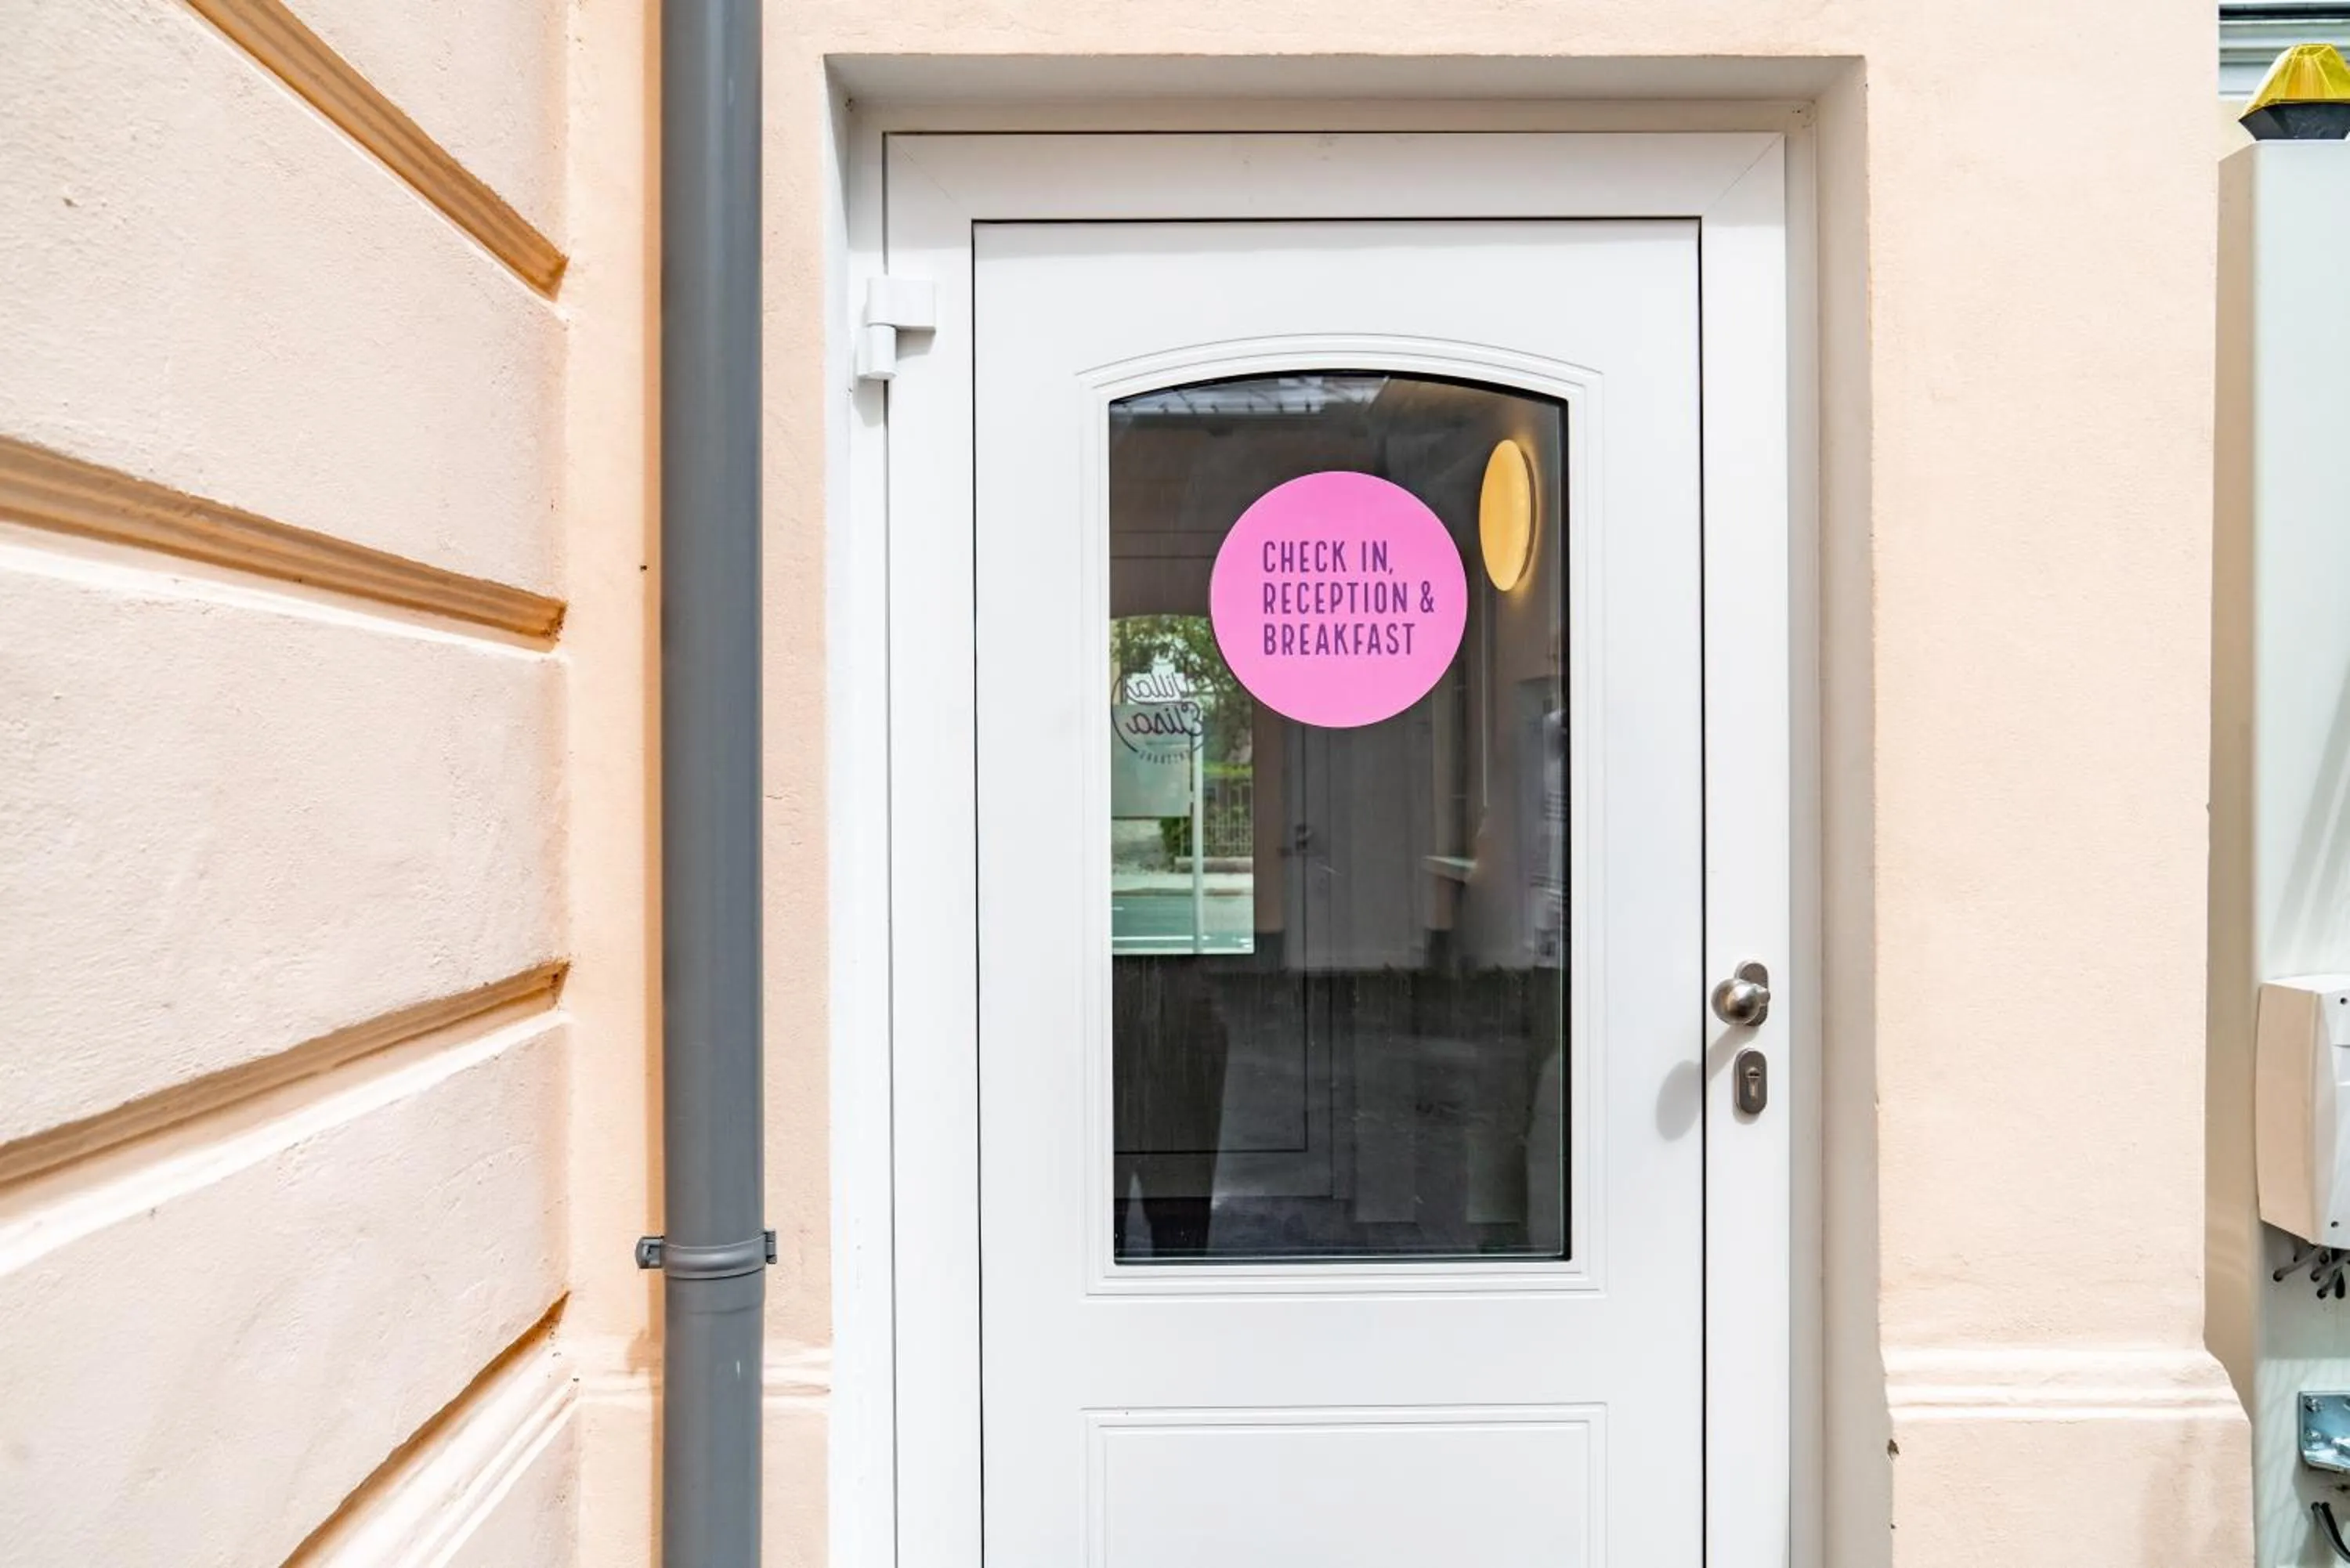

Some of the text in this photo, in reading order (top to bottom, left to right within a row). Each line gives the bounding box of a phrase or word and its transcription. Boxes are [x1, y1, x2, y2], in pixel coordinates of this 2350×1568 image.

[1263, 540, 1394, 576] CHECK IN,
[1263, 580, 1435, 615] RECEPTION &
[1263, 623, 1415, 656] BREAKFAST
